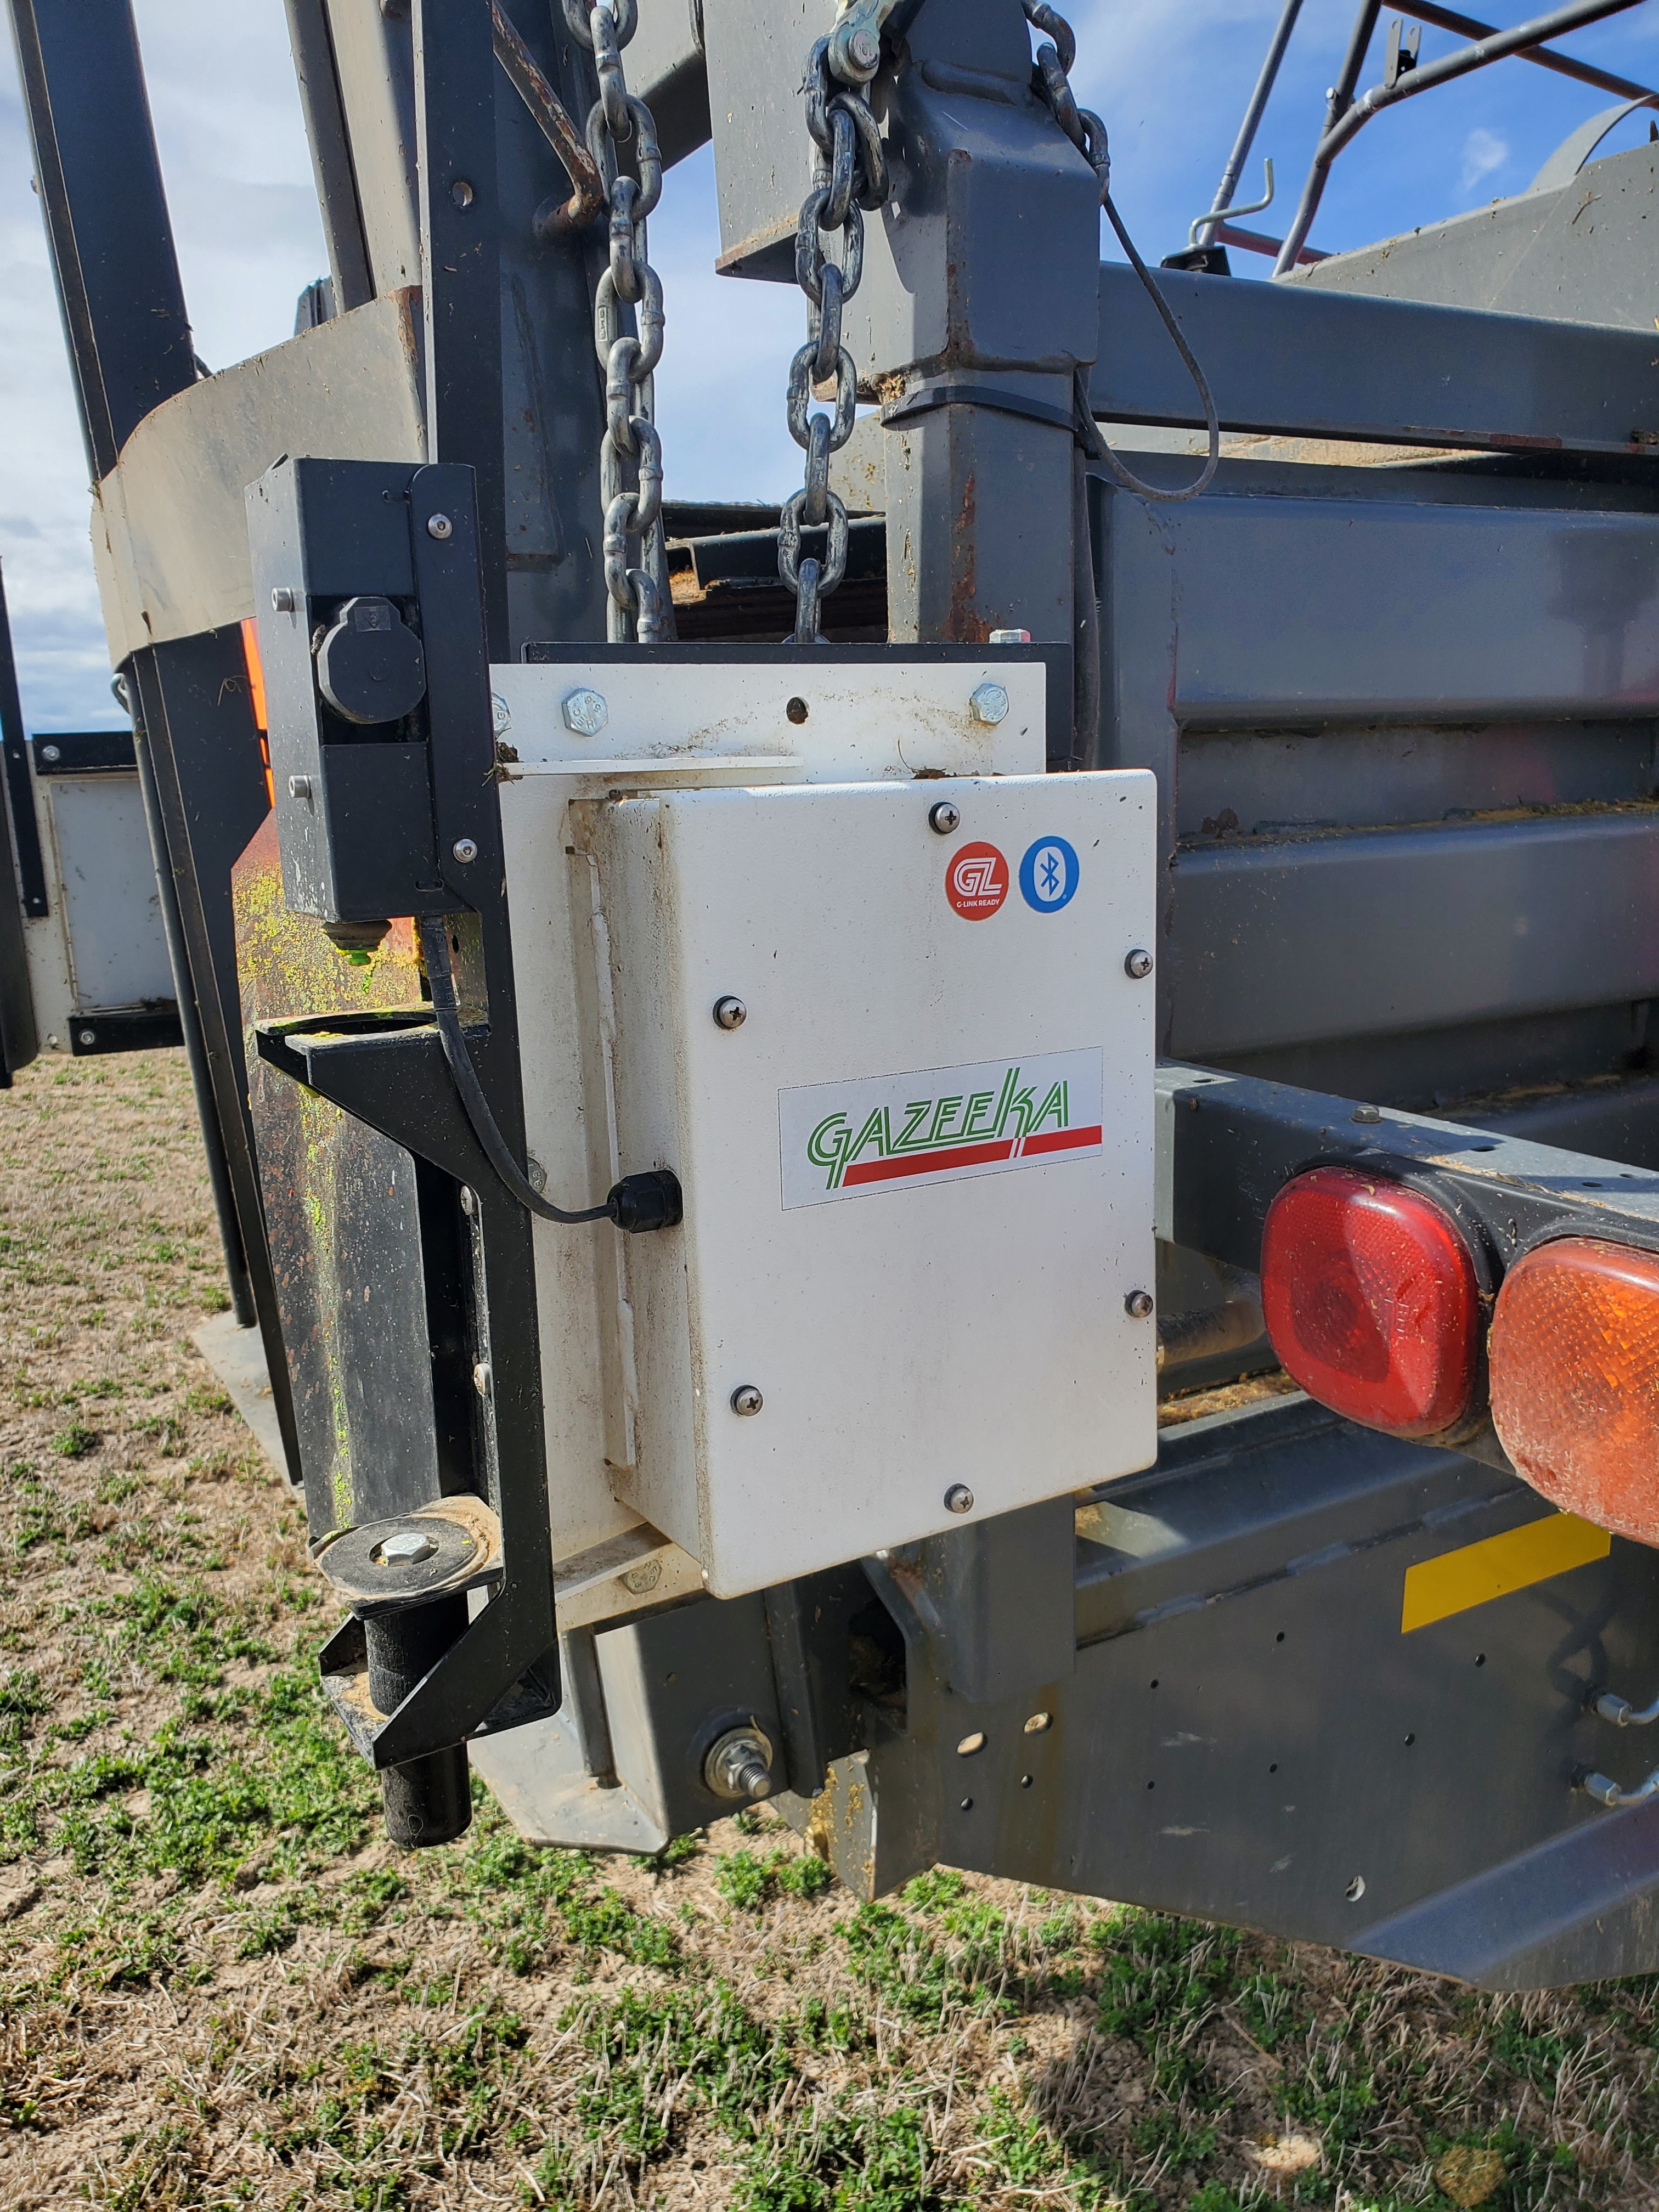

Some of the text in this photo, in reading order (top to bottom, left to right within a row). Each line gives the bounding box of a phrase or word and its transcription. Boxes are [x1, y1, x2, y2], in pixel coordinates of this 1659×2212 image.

[953, 857, 1003, 897] GL
[956, 899, 1000, 908] G-LINK READY
[807, 1067, 1069, 1190] GAZEEKA
